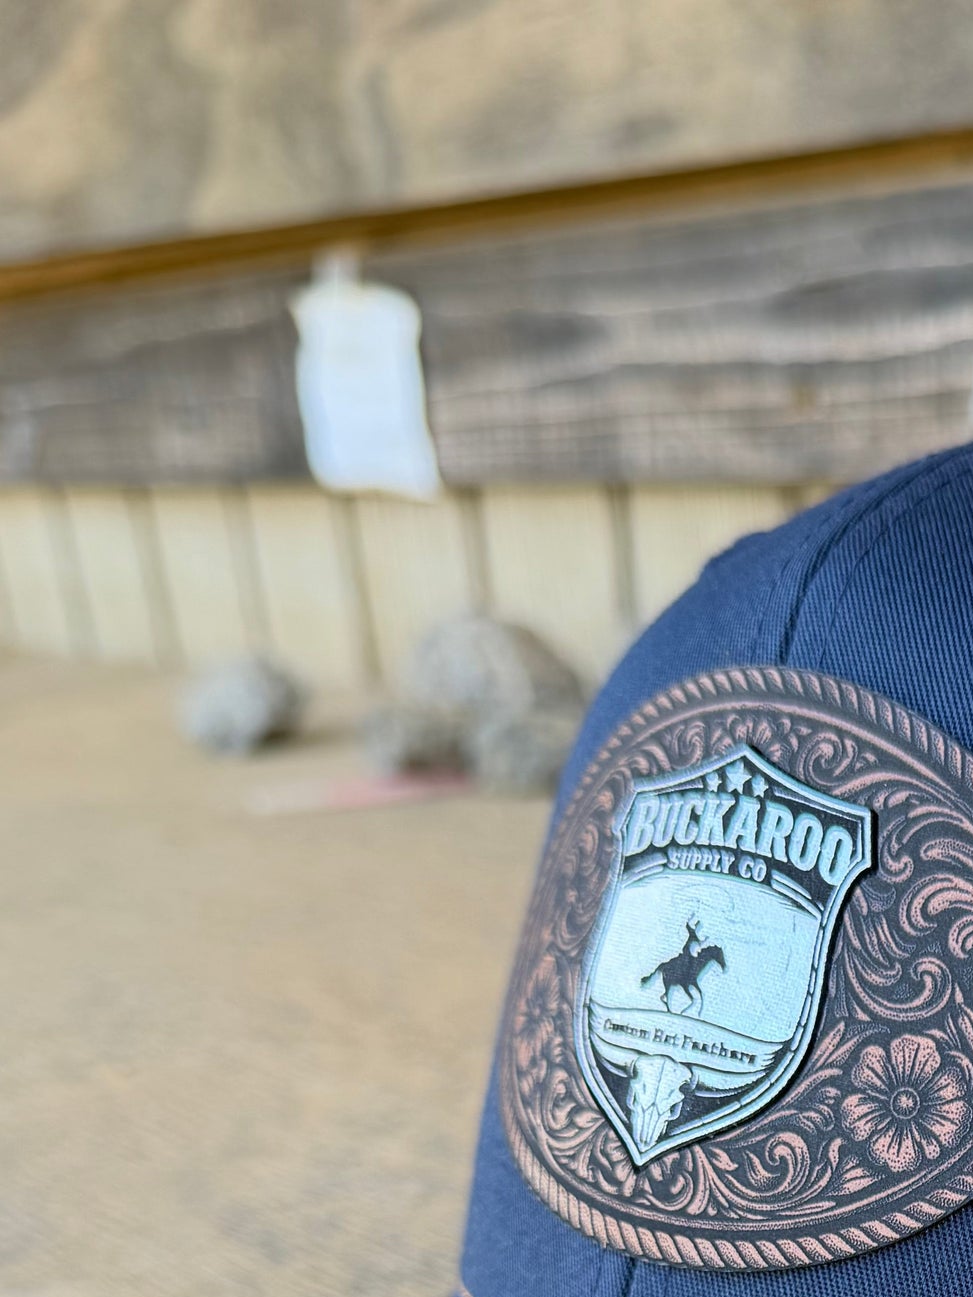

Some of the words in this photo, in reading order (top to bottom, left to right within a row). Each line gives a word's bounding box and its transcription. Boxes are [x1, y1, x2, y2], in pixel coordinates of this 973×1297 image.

[625, 793, 854, 886] BUCKAROO
[666, 849, 735, 874] SUPPLY
[738, 857, 767, 882] CO
[603, 1018, 649, 1040] Custom
[652, 1027, 679, 1046] Hat
[681, 1034, 757, 1065] Feathers
